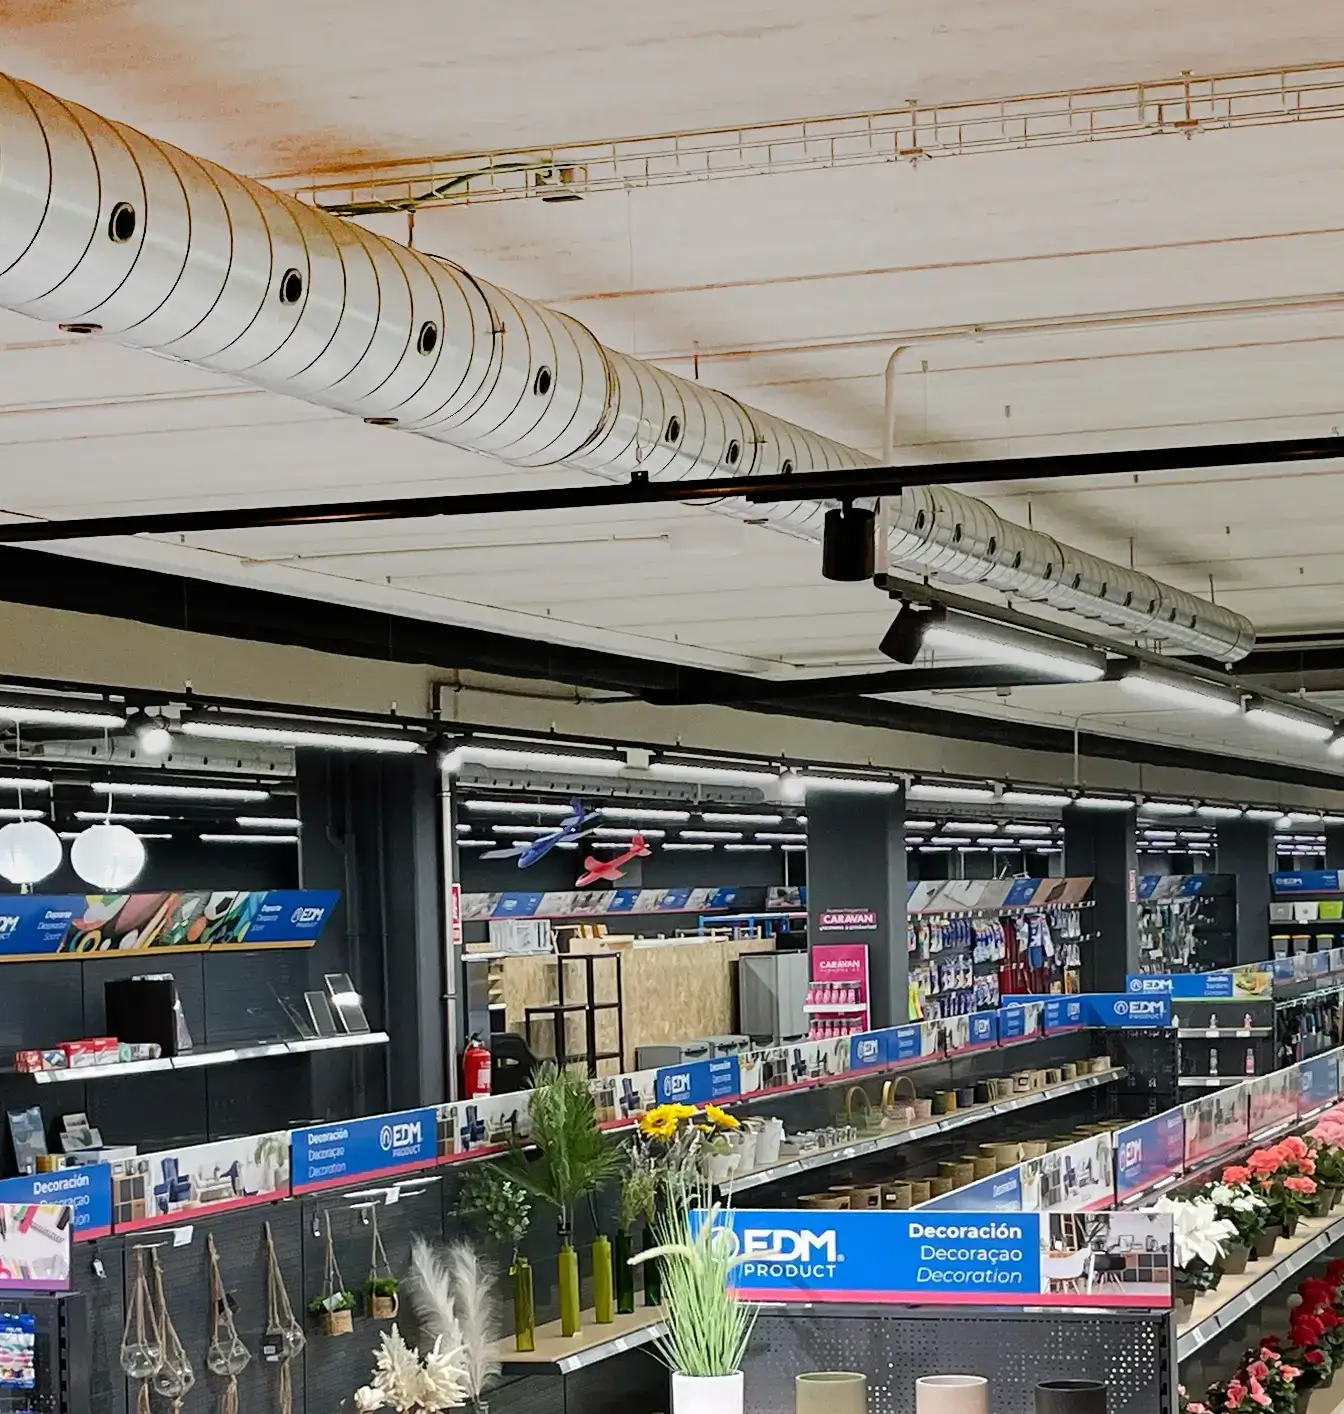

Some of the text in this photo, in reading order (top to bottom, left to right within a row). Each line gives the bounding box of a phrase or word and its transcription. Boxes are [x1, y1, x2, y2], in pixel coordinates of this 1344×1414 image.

[823, 914, 873, 924] CARAVAN
[819, 959, 860, 968] CARAVAN
[1143, 979, 1172, 990] EDM
[1129, 1001, 1164, 1014] EDM
[393, 1121, 422, 1147] EDM
[33, 1173, 90, 1195] Decoración
[908, 1222, 1023, 1239] Decoración
[744, 1228, 837, 1262] EDM
[744, 1263, 837, 1278] PRODUCT
[916, 1266, 1022, 1284] Decoration
